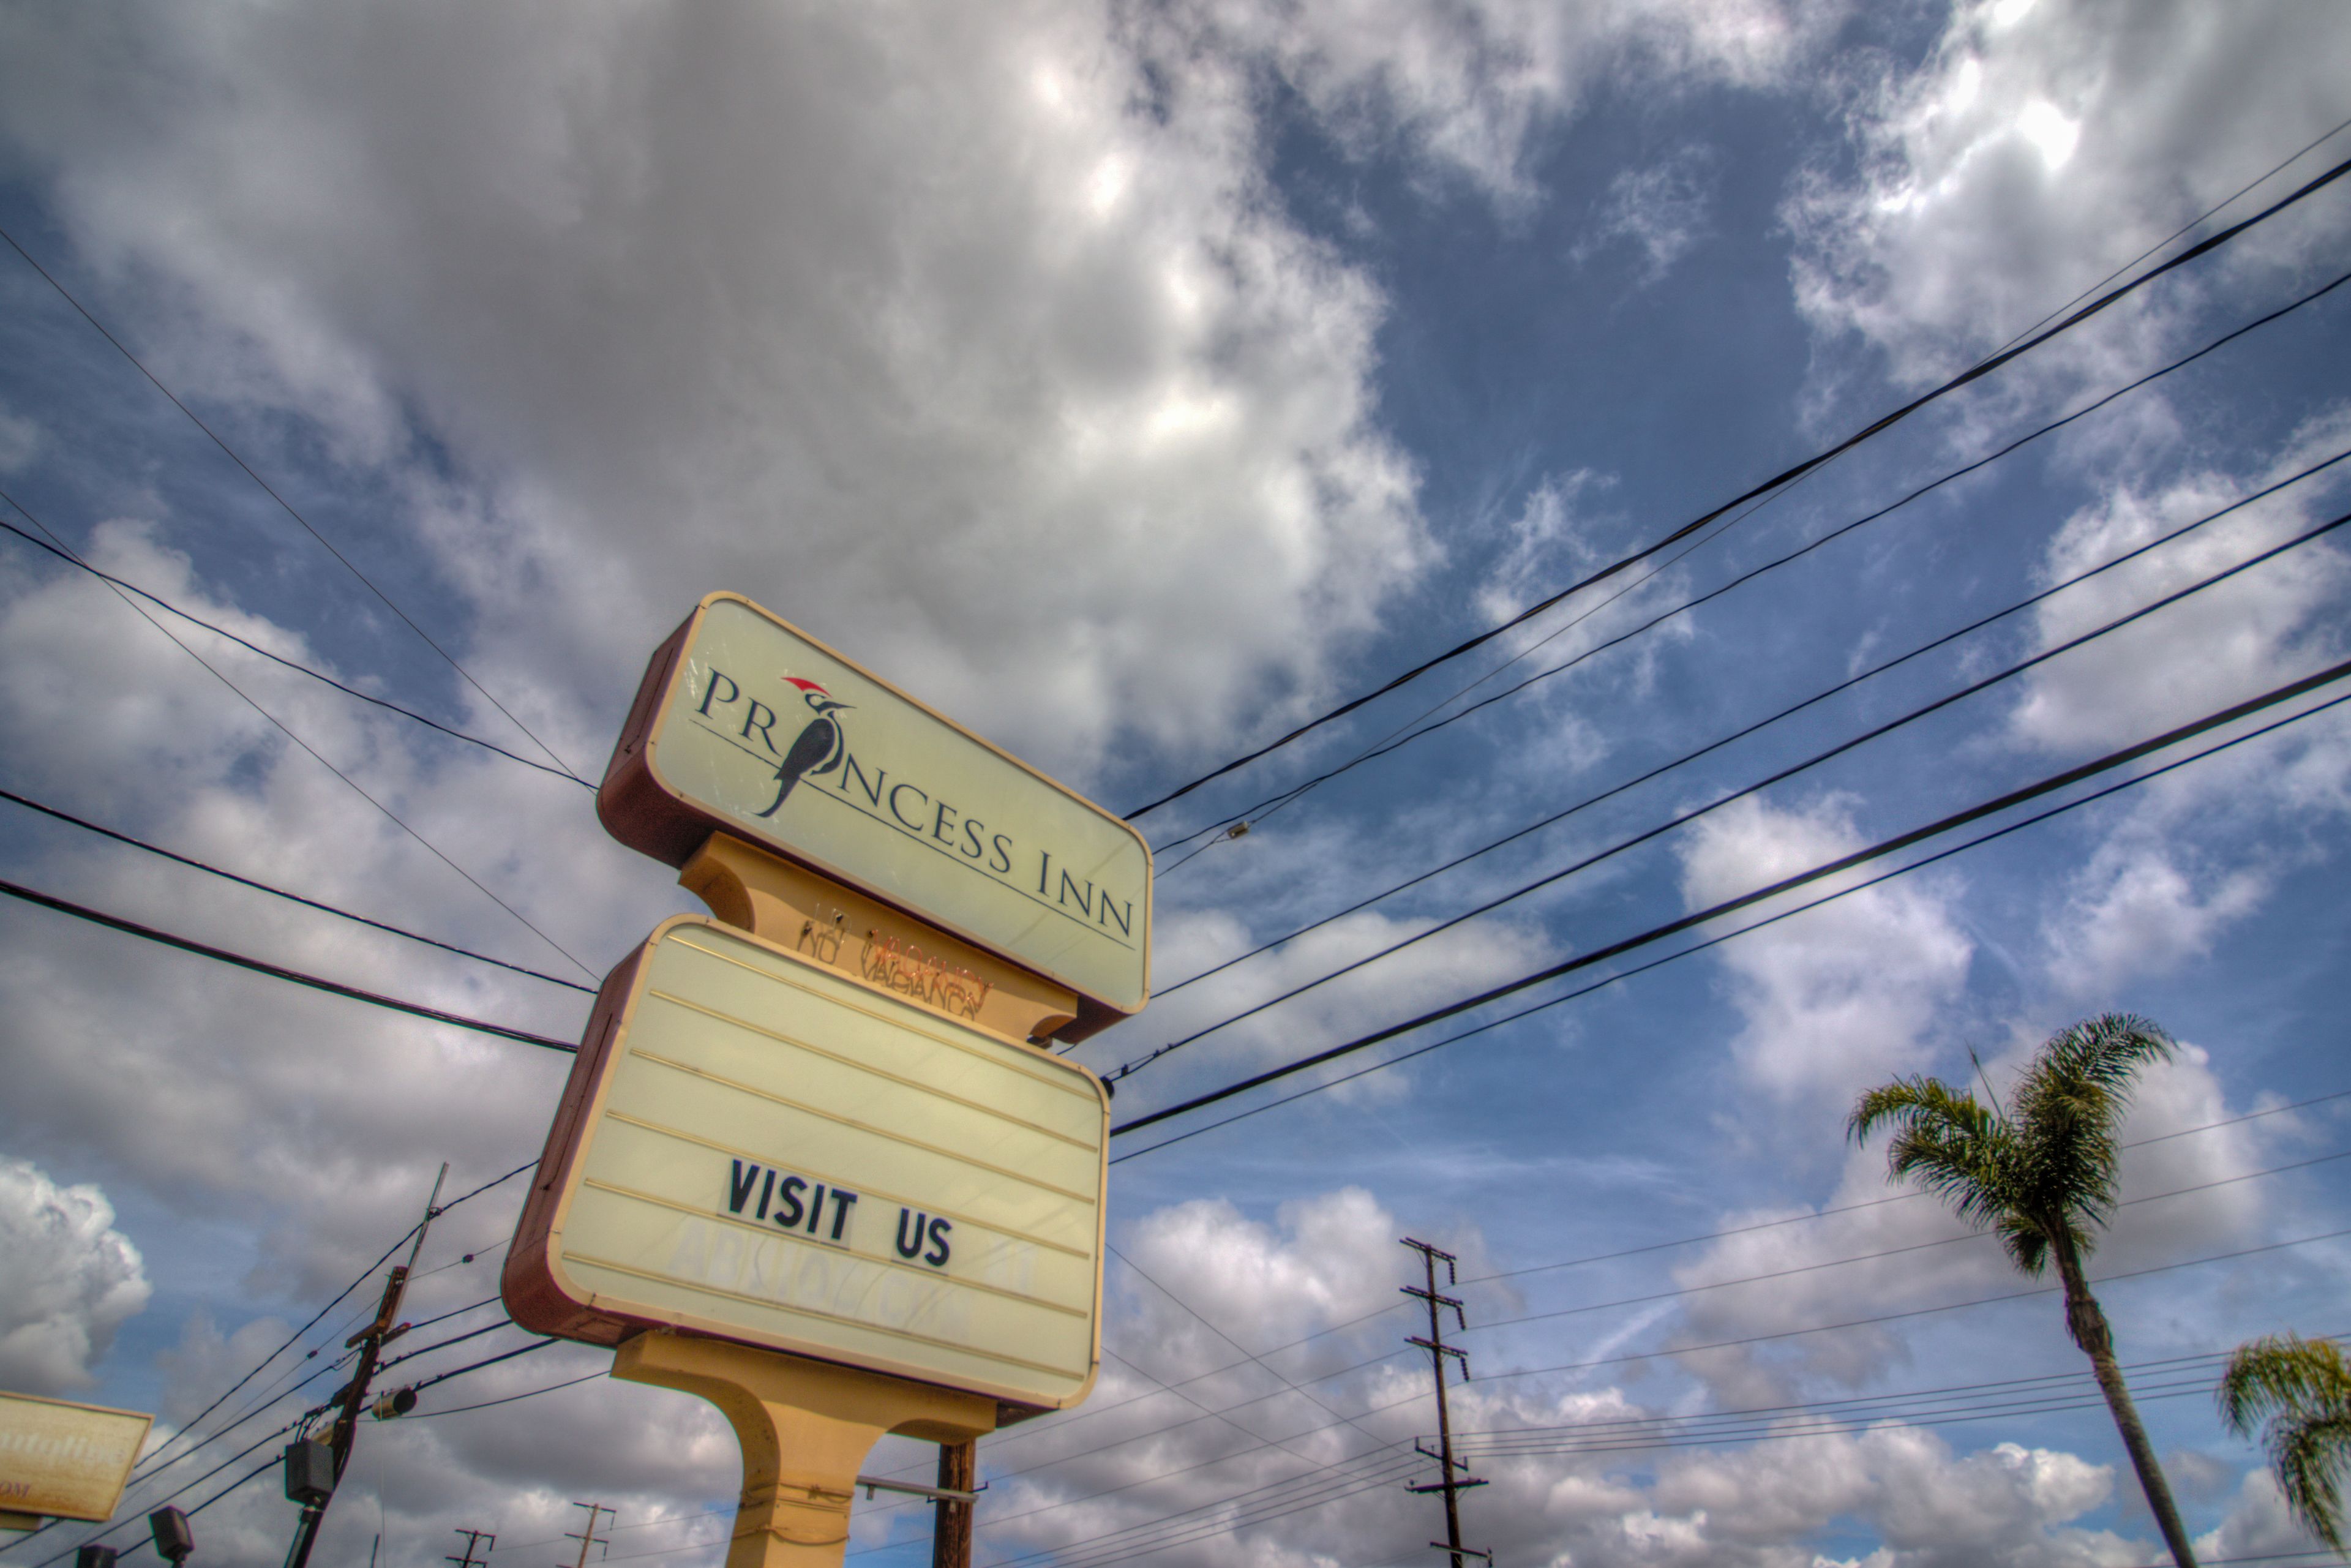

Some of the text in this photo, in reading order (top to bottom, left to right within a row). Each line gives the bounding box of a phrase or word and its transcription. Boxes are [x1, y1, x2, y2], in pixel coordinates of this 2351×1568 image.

[1037, 849, 1133, 938] INN
[860, 929, 994, 1021] VACANCY
[729, 1158, 858, 1240] VISIT
[896, 1207, 953, 1267] US
